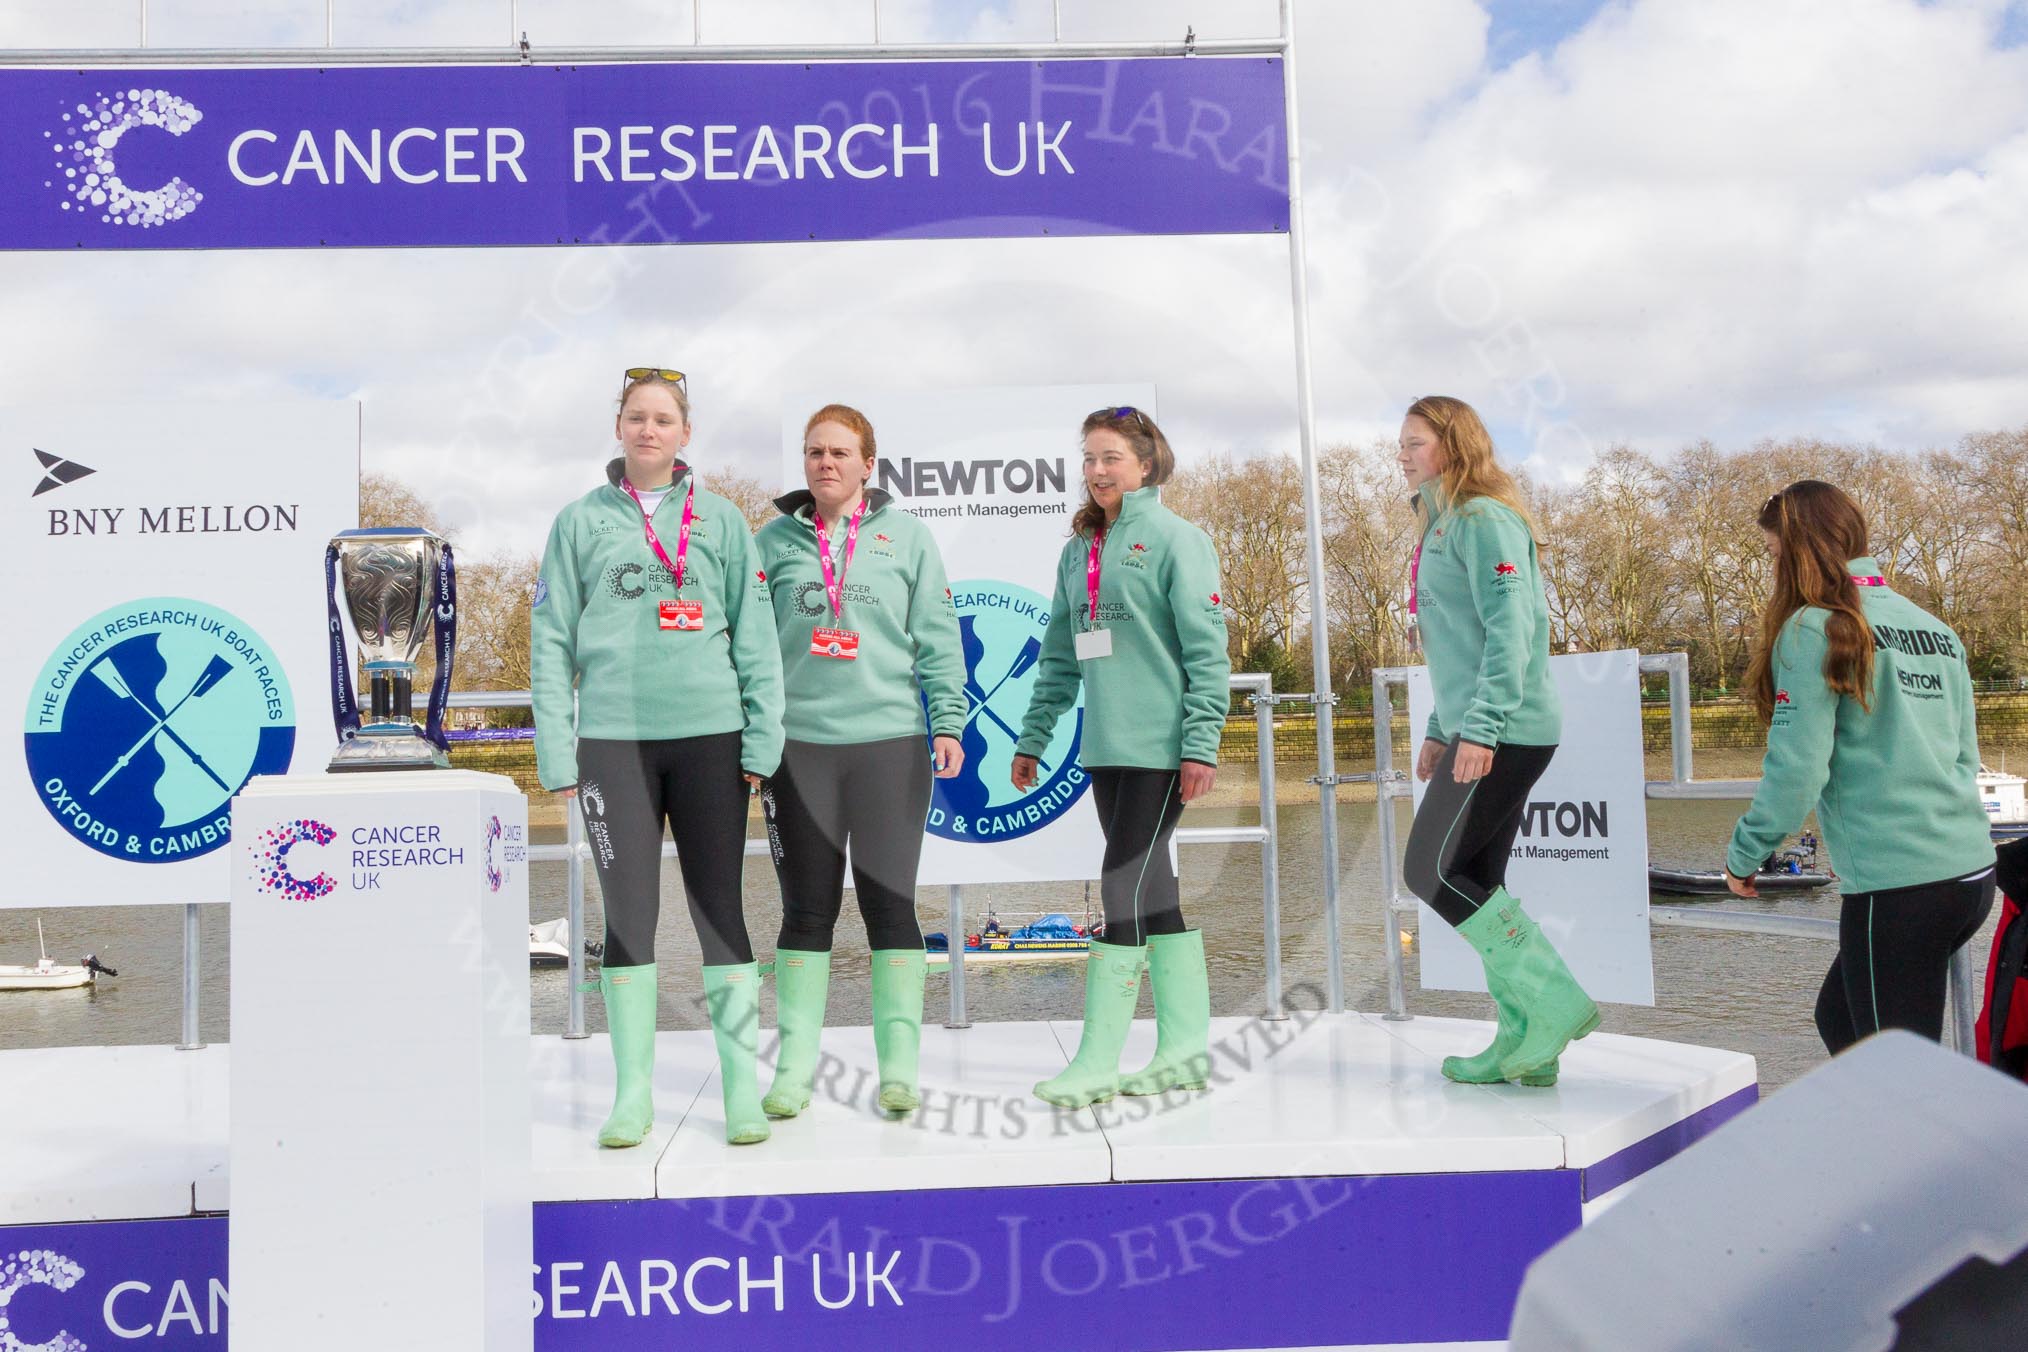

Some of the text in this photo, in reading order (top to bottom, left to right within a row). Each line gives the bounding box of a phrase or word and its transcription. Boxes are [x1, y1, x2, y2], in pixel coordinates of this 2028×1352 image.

[228, 120, 1074, 186] CANCER RESEARCH UK
[877, 457, 1066, 498] NEWTON
[48, 504, 300, 536] BNY MELLON
[967, 501, 1067, 518] Management
[648, 584, 663, 593] UK
[953, 592, 1037, 619] EARCH UK
[39, 610, 283, 726] THE CANCER RESEARCH UK BOAT RACES
[45, 777, 231, 855] OXFORD & CAMBR
[952, 815, 968, 834] &
[352, 825, 441, 846] CANCER
[593, 821, 609, 869] RESEARCH
[600, 821, 615, 861] CANCER
[772, 823, 785, 858] CANCER
[352, 847, 464, 868] RESEARCH
[1525, 845, 1610, 862] Management
[352, 872, 381, 891] UK
[103, 1278, 229, 1339] CAN
[812, 1250, 904, 1309] UK
